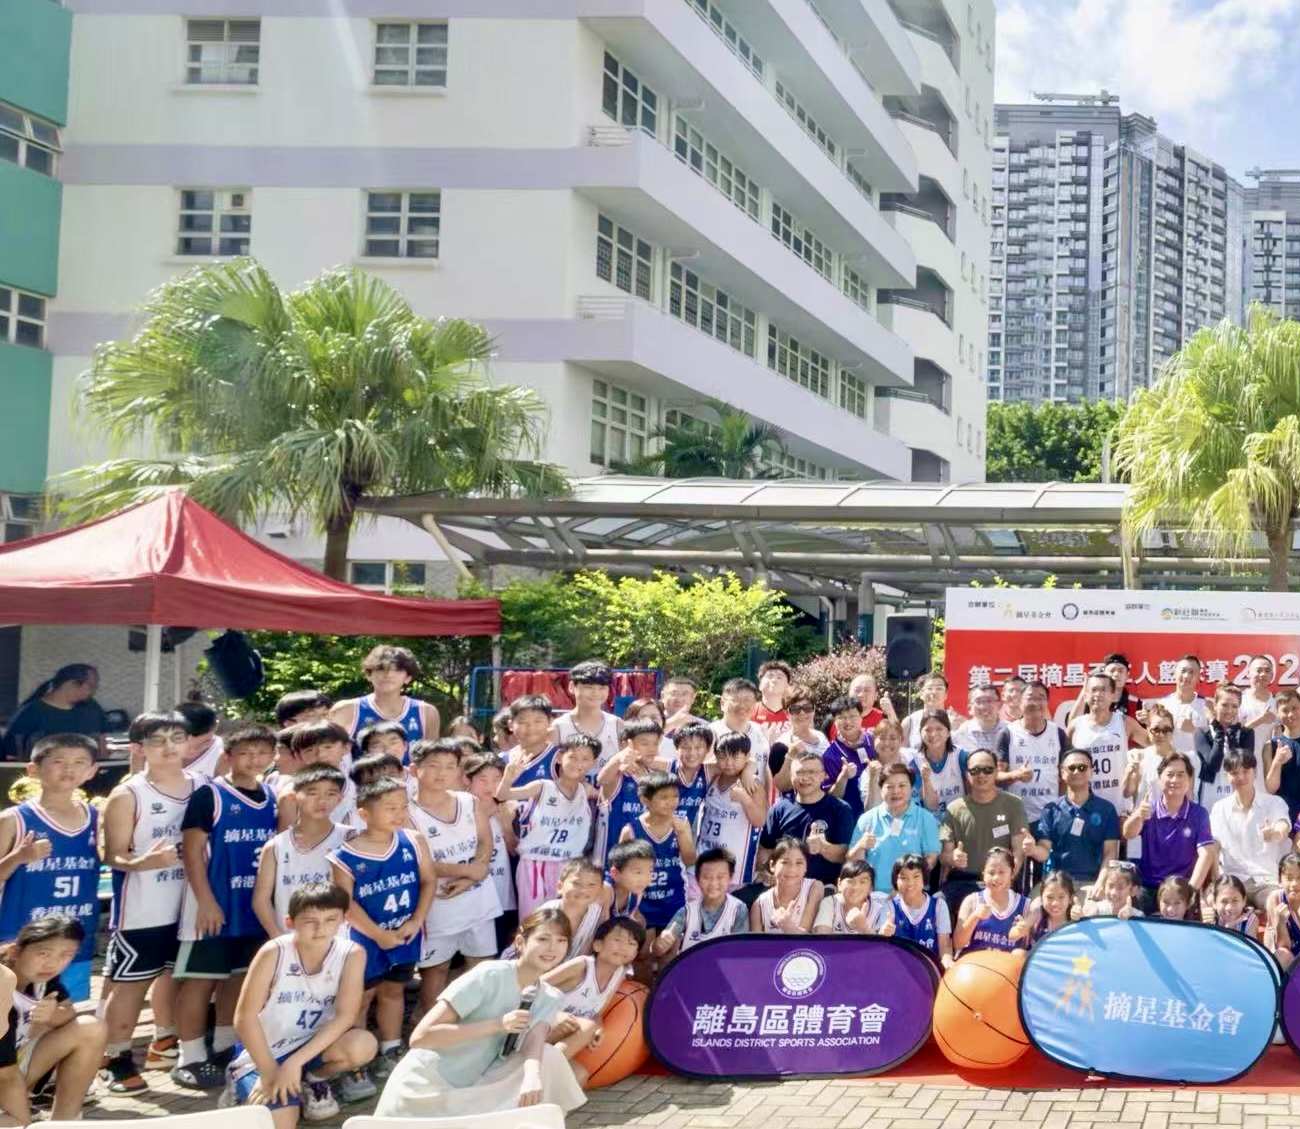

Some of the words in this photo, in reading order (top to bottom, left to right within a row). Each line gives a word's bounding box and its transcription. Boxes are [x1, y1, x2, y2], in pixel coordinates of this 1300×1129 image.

[968, 658, 1229, 689] 第二屆摘星人籃賽
[1092, 758, 1111, 775] 40
[53, 875, 80, 898] 51
[383, 889, 411, 914] 44
[296, 1009, 323, 1030] 47
[692, 1002, 890, 1036] 離島區體育會
[1103, 991, 1244, 1036] 摘星基金會
[692, 1038, 732, 1047] ISLANDS
[734, 1038, 777, 1047] DISTRICT
[778, 1037, 815, 1047] SPORTS
[817, 1036, 881, 1047] ASSOCIATION
